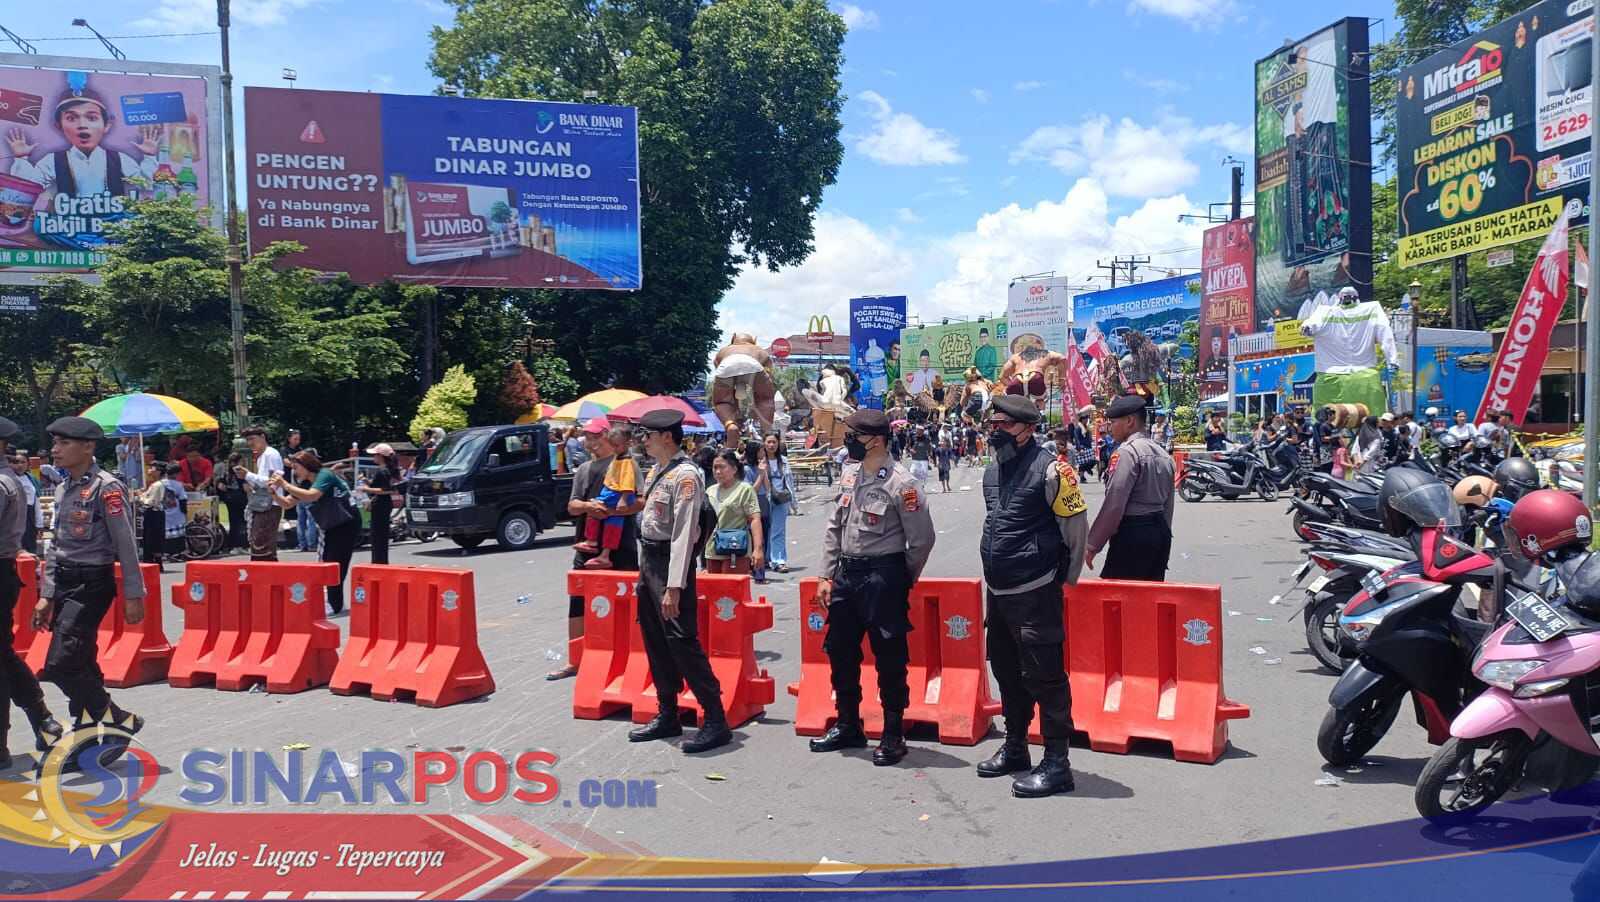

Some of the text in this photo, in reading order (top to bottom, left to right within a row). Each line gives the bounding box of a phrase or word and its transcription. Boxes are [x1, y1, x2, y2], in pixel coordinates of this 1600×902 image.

[1424, 49, 1503, 100] Mitra10
[1540, 92, 1585, 113] MESIN CUCI
[560, 113, 623, 129] BANK DINAR
[1435, 115, 1452, 130] BELI
[447, 136, 571, 157] TABUNGAN
[1414, 113, 1514, 165] LEBARAN SALE
[256, 152, 345, 171] PENGEN
[435, 157, 592, 179] DINAR JUMBO
[1427, 142, 1497, 187] DISKON
[256, 173, 378, 193] UNTUNG??
[54, 190, 124, 216] Gratis
[257, 198, 370, 215] Ya Nabungnya
[522, 193, 560, 201] Tabungan
[580, 195, 619, 203] DEPOSITO
[522, 201, 628, 211] Dengan Keuntungan JUMBO
[37, 211, 87, 237] Takjil
[258, 214, 379, 230] di Bank Dinar
[421, 218, 483, 237] JUMBO
[1408, 203, 1552, 250] JL. TERUSAN BUNG HATTA
[1404, 243, 1448, 261] KARANG
[1450, 234, 1482, 251] BARU
[1492, 214, 1560, 241] MATARAM
[34, 250, 58, 264] 0817
[1125, 301, 1141, 312] FOR
[1142, 294, 1184, 309] EVERYONE
[853, 309, 904, 320] POCARI SWEAT
[1484, 287, 1545, 419] HONDA
[1531, 604, 1555, 622] 4304
